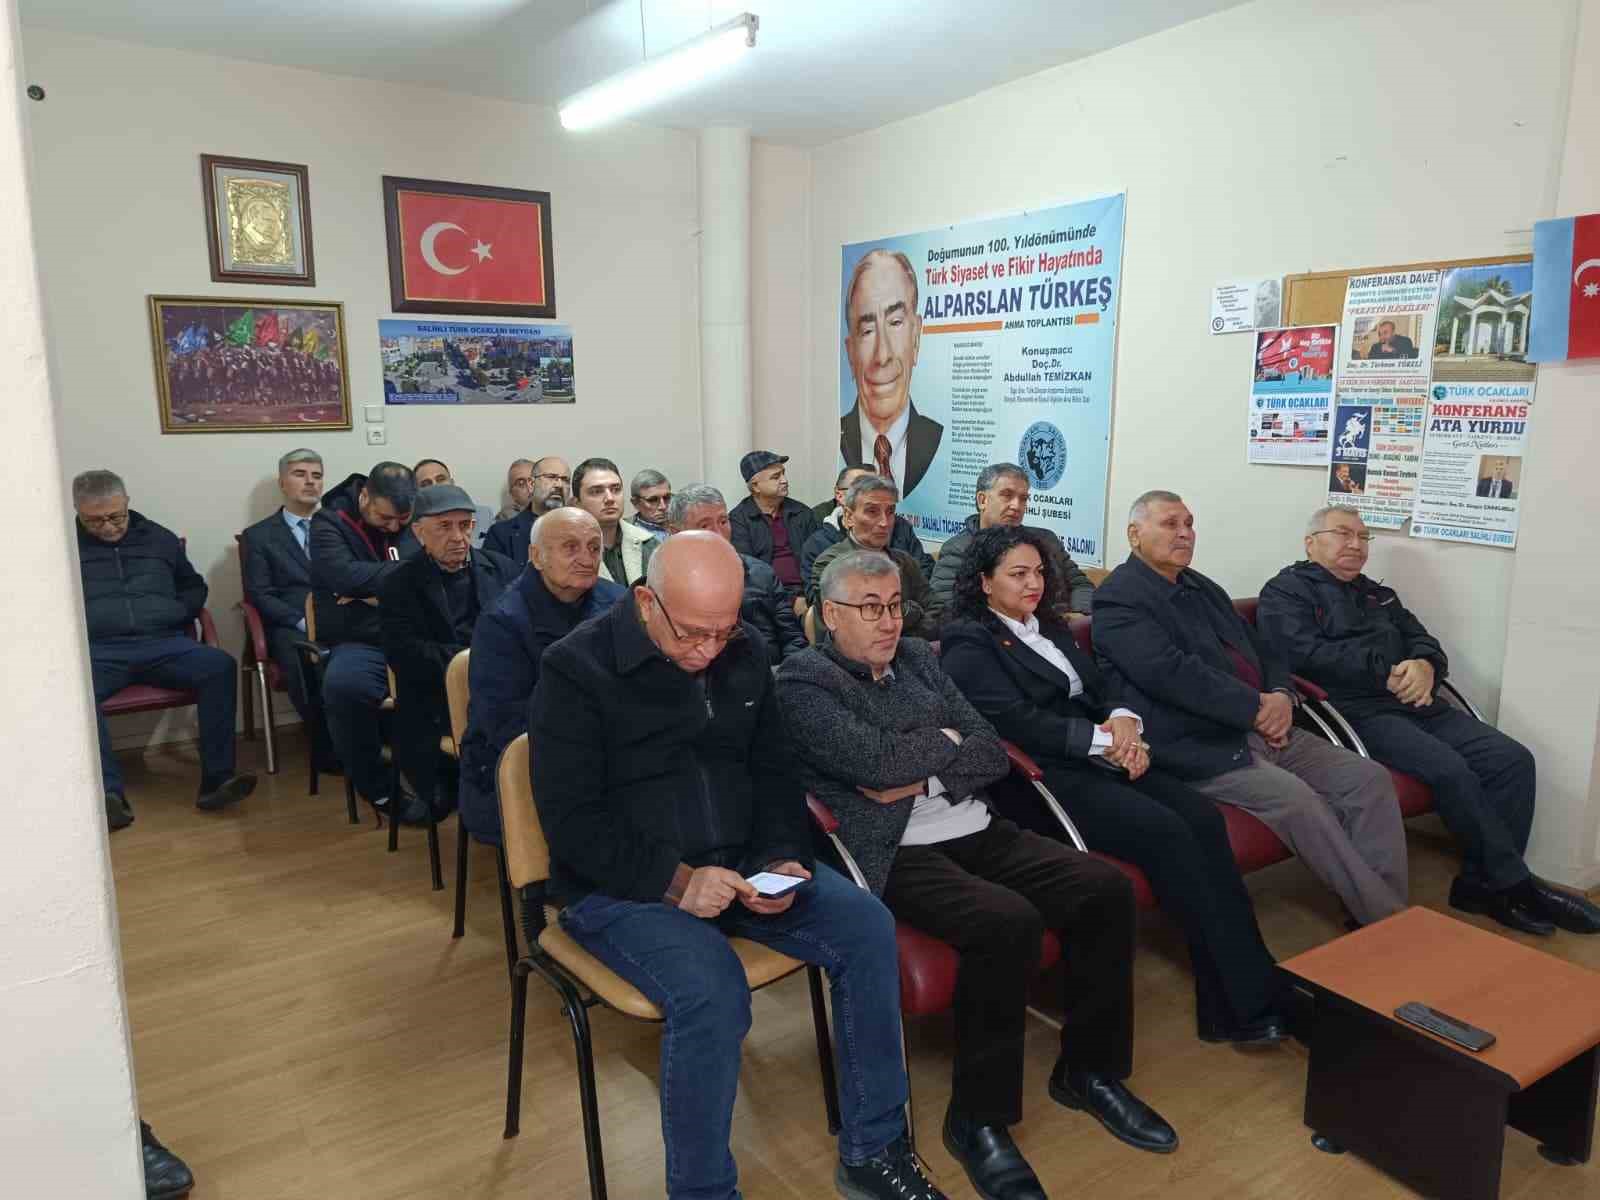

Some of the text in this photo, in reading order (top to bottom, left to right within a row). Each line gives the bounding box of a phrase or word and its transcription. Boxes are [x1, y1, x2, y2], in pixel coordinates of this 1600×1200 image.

[927, 224, 1097, 263] Doğumunun 100. Yıldönümünde
[925, 245, 1103, 287] Türk Siyaset ve Fikir Hayatında
[1350, 272, 1439, 289] KONFERANSA DAVET
[923, 276, 1113, 319] ALPARSLAN TÜRKEŞ
[1004, 316, 1073, 330] ANMA TOPLANTISI
[1003, 371, 1092, 382] Abdullah TEMİZKAN
[1448, 385, 1529, 397] TÜRK OCAKLARI
[1266, 398, 1287, 409] TÜRK
[1288, 397, 1329, 409] OCAKLARI
[1432, 403, 1528, 418] KONFERANS
[1430, 419, 1526, 434] ATA YURDU
[1033, 494, 1073, 506] OCAKLARI
[1042, 508, 1071, 520] ŞUBESİ
[1066, 536, 1096, 556] SALONU
